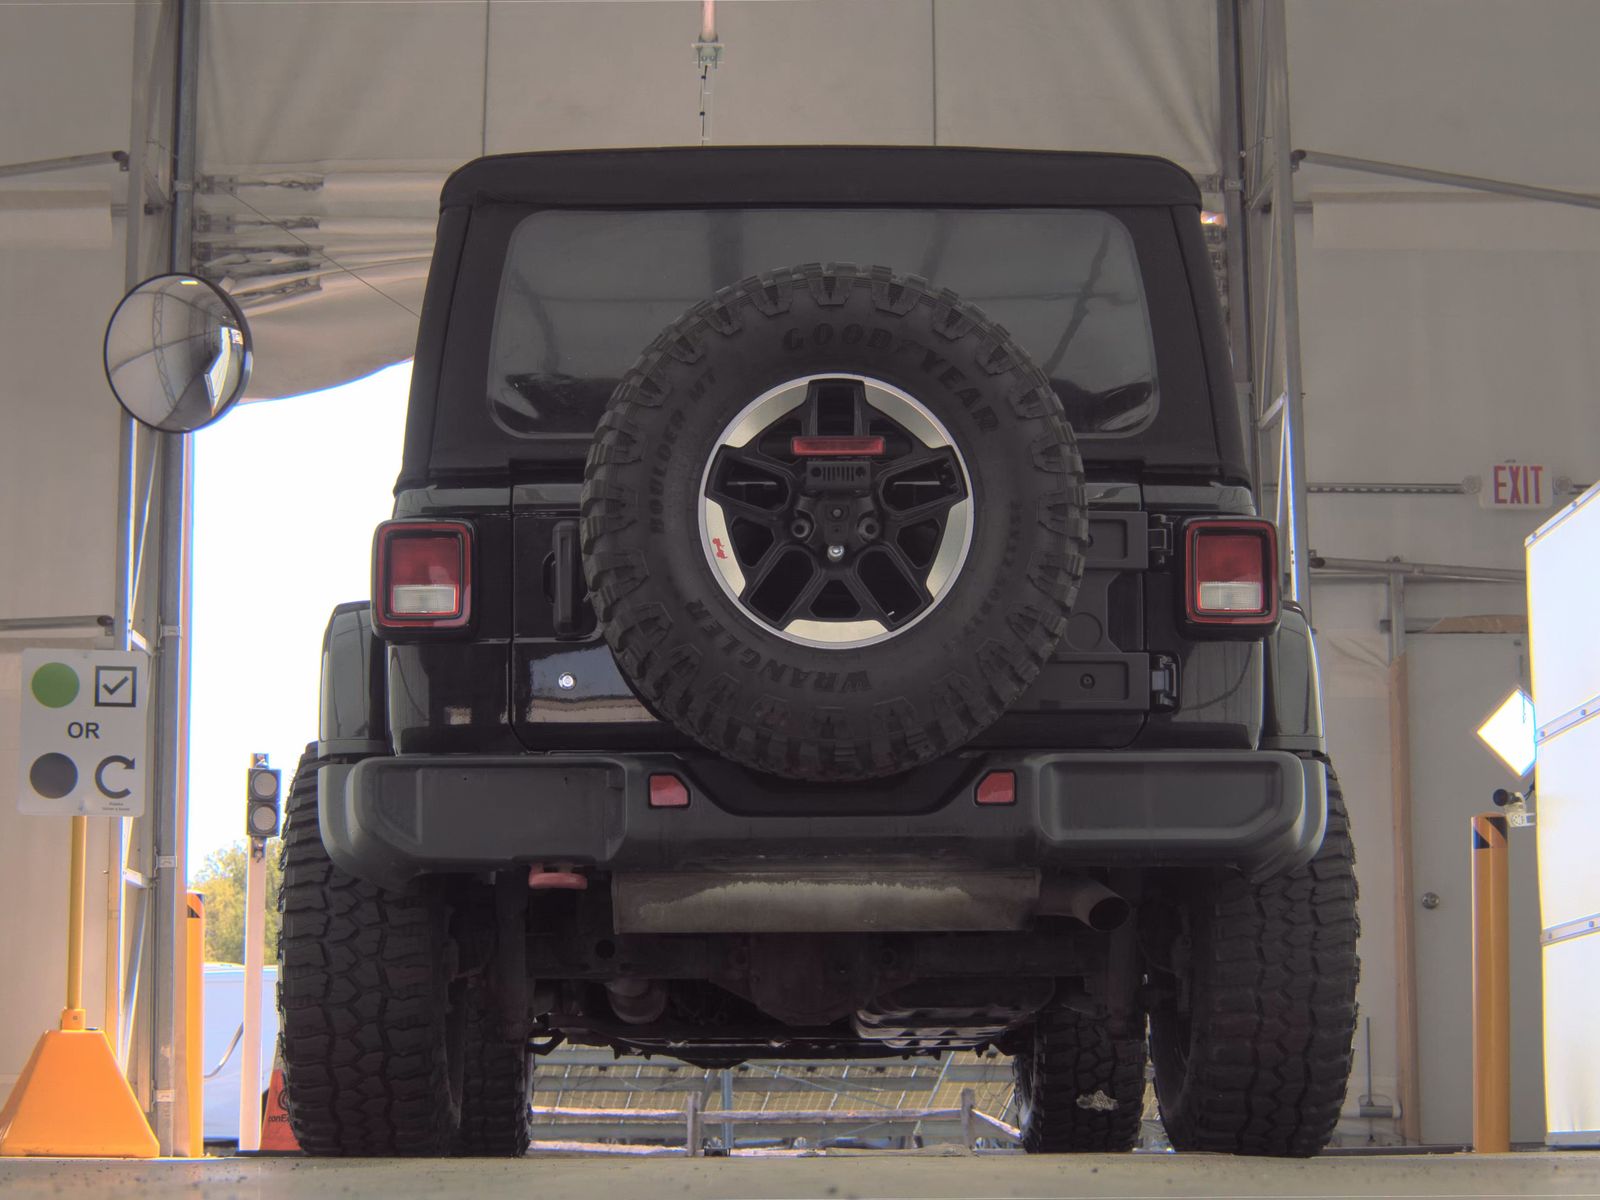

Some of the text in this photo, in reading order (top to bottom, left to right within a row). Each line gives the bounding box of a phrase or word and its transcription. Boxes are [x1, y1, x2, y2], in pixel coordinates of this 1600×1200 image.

[782, 322, 999, 433] GOODYEAR
[1493, 465, 1543, 505] EXIT
[684, 599, 872, 693] WRANGLER
[67, 721, 100, 739] OR
